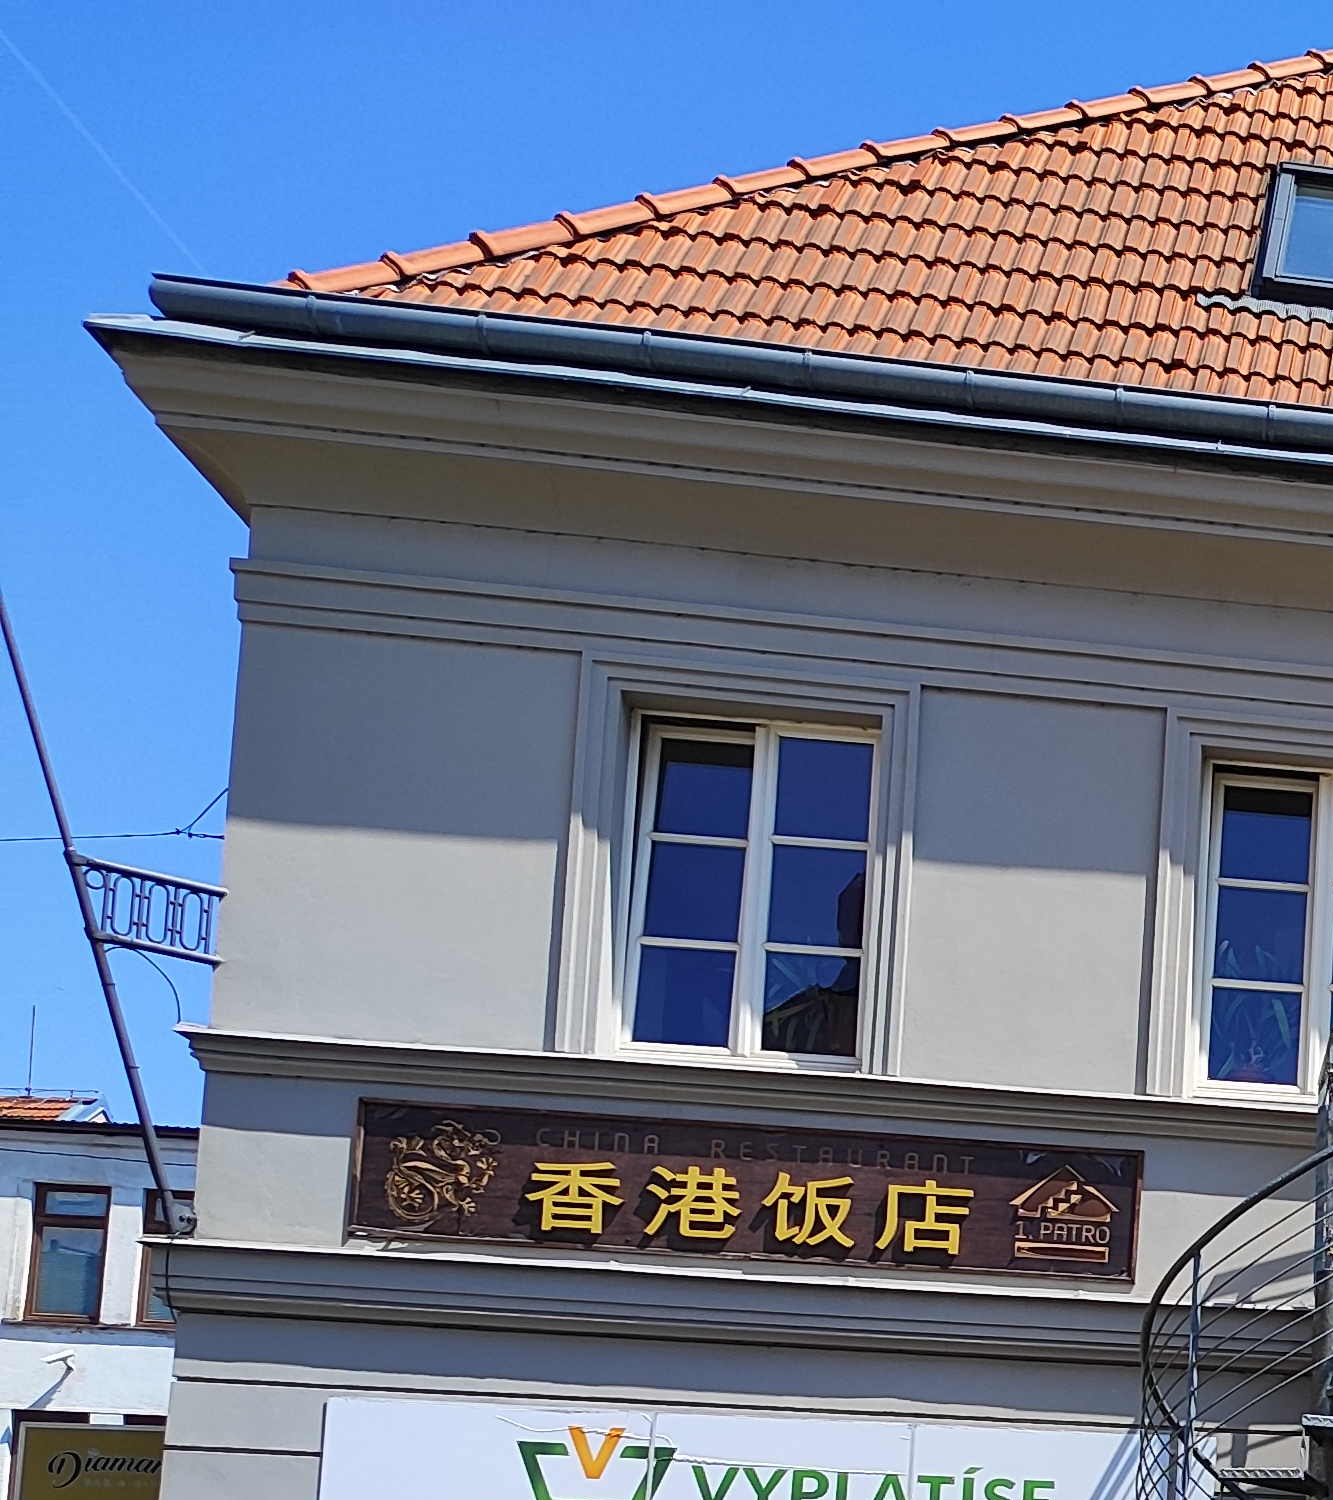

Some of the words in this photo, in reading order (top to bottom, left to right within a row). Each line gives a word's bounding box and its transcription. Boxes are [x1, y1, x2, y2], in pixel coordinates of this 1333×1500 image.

[536, 1127, 660, 1154] CHINA
[711, 1138, 975, 1175] RESTAURANT
[525, 1161, 974, 1255] 香港饭店
[1040, 1223, 1111, 1244] PATRO
